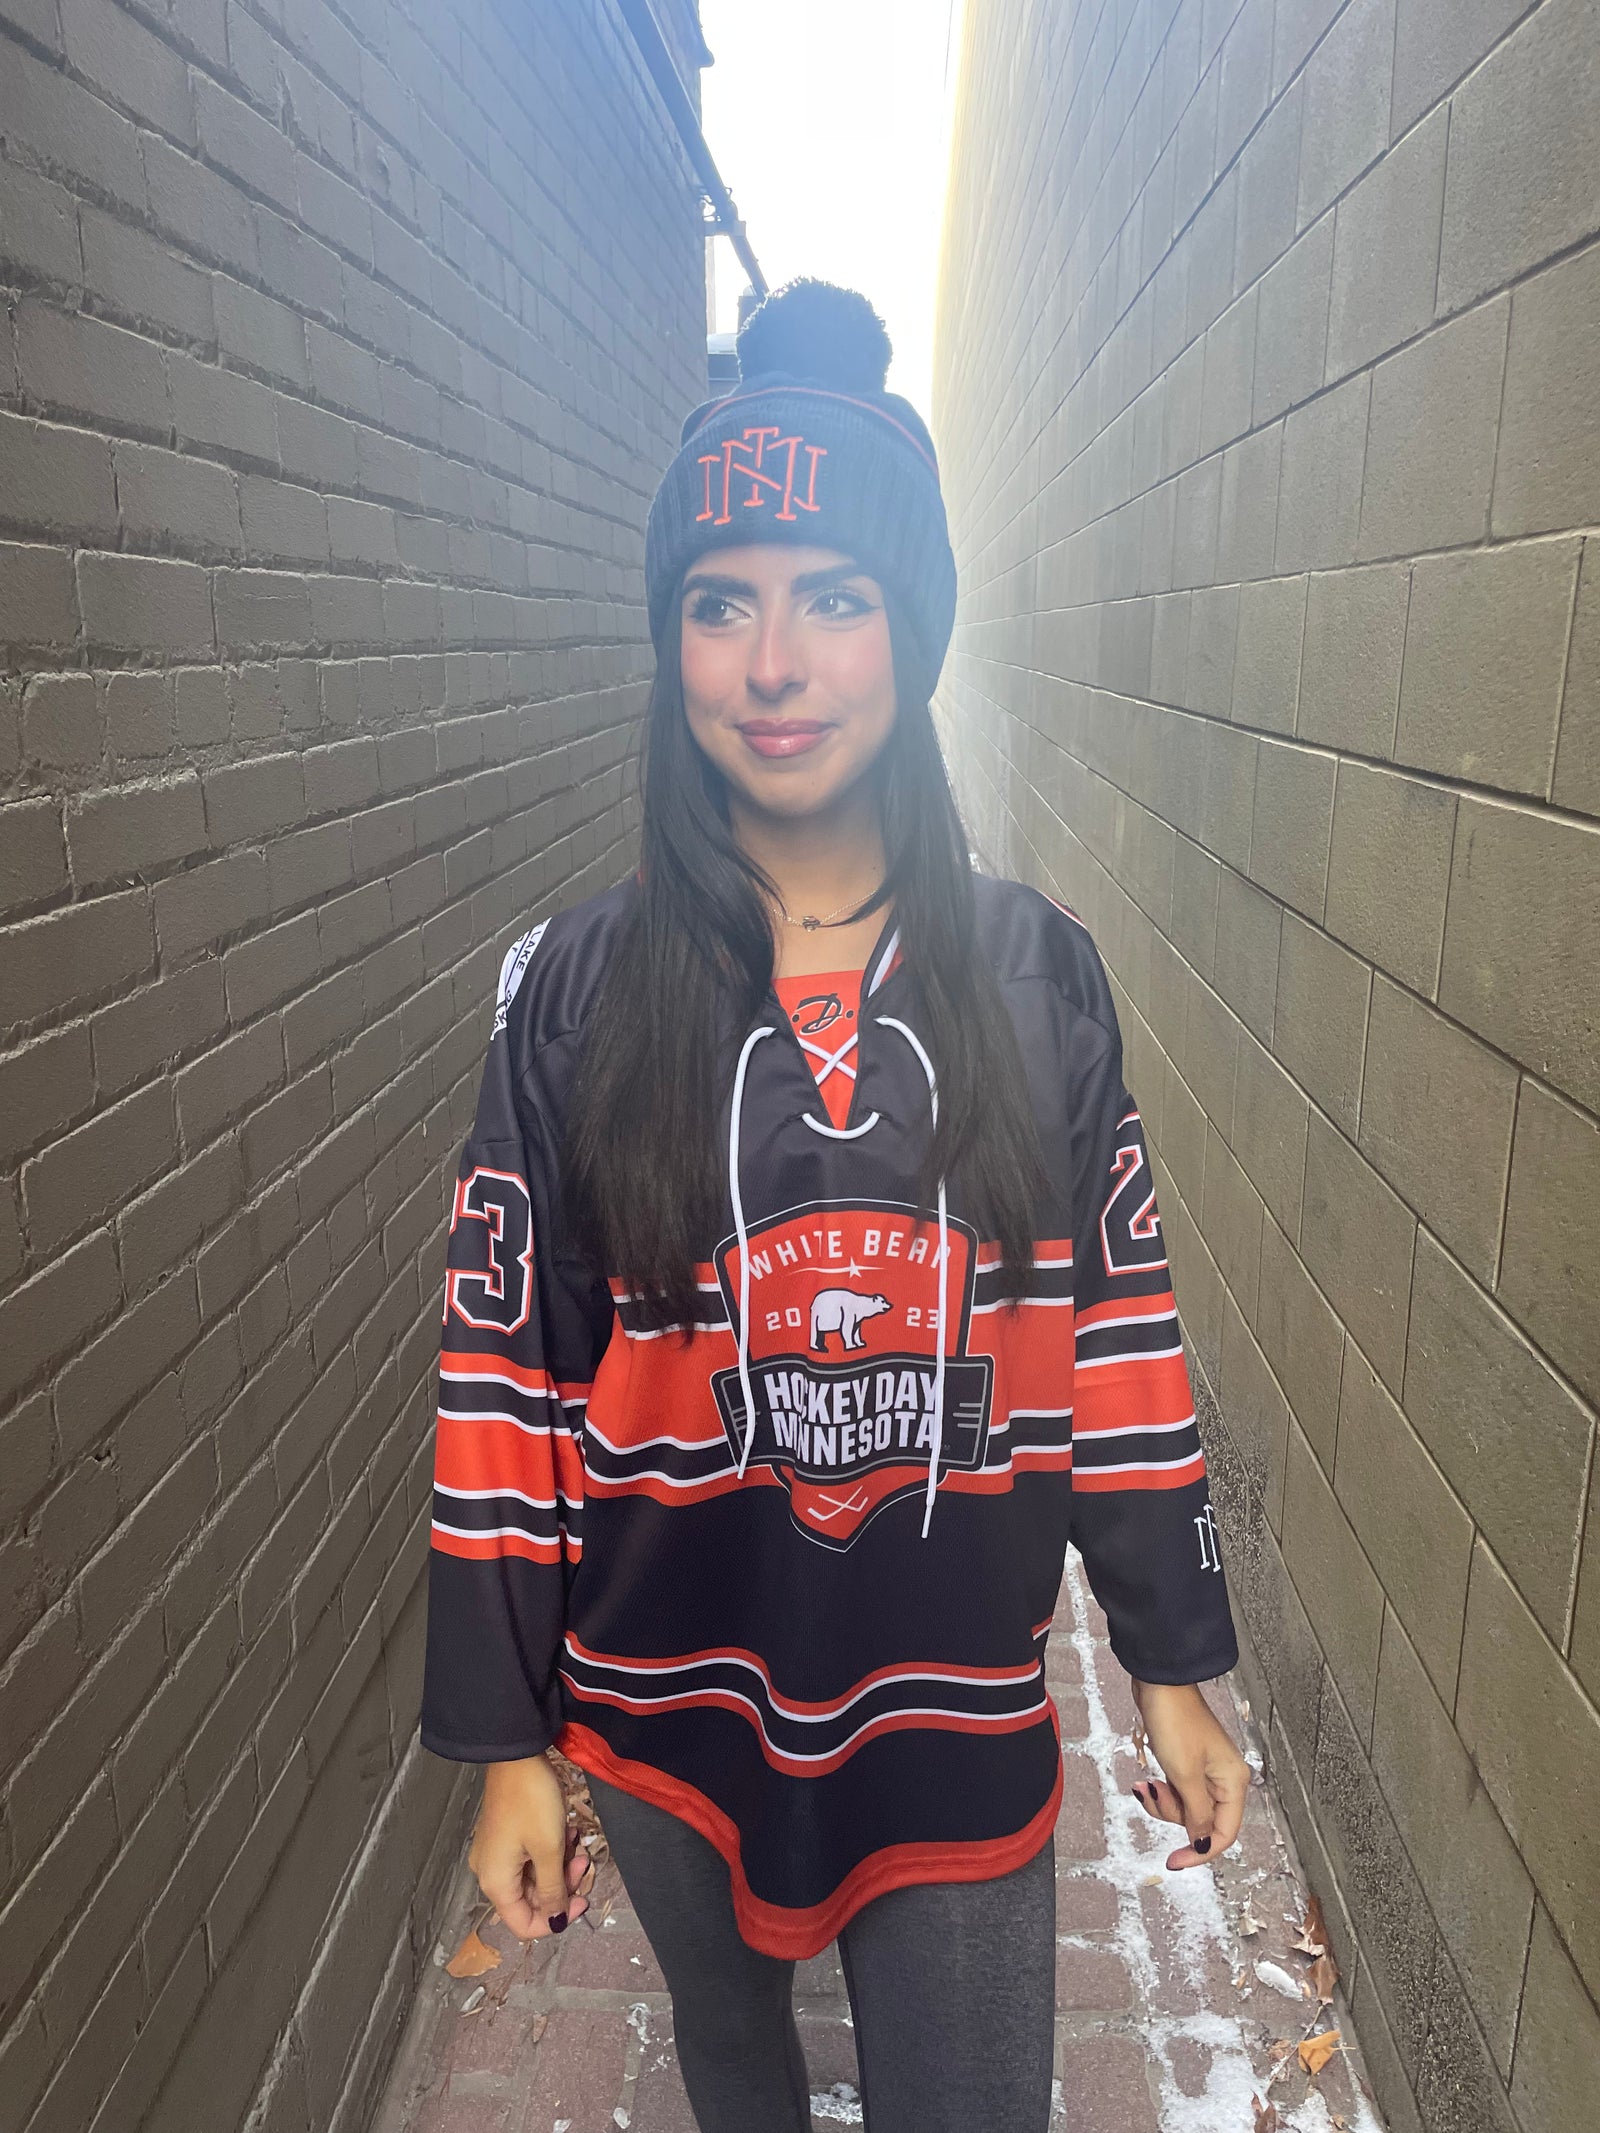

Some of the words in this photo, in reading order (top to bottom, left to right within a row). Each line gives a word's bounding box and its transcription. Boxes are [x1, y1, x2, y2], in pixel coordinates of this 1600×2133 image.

[749, 1231, 843, 1280] WHITE
[766, 1307, 801, 1331] 20
[906, 1306, 939, 1329] 23
[875, 1371, 938, 1413] DAY
